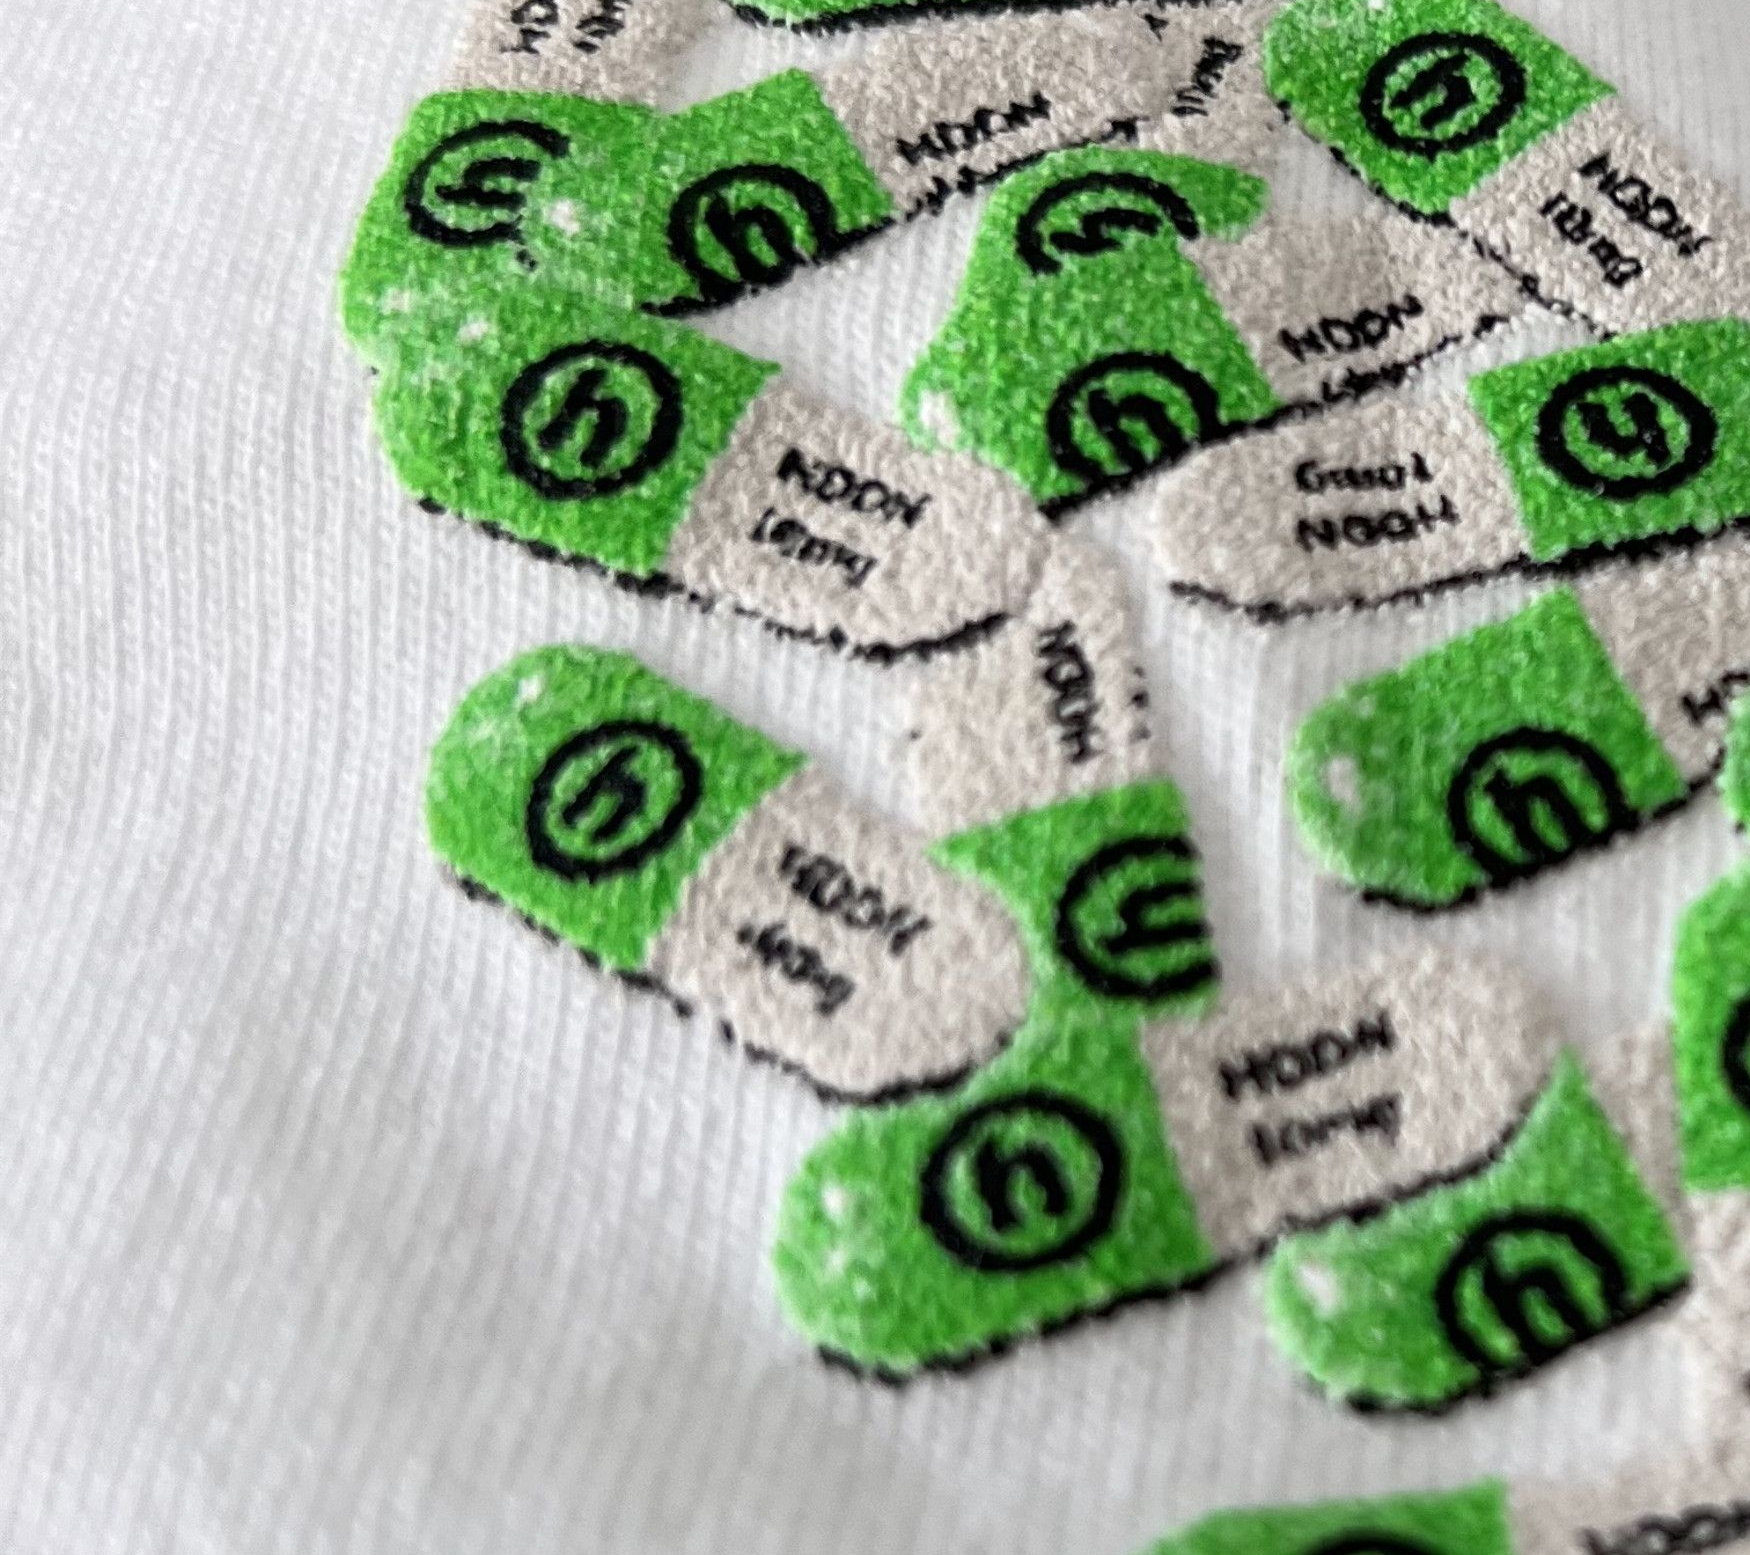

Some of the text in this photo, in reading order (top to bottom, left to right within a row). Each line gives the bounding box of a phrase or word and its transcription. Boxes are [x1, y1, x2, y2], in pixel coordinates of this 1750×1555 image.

[1577, 151, 1714, 259] HOON
[1278, 293, 1424, 363] HOON
[775, 447, 934, 528] HOON
[1295, 494, 1461, 552] HOON
[1217, 1010, 1400, 1103] HOON
